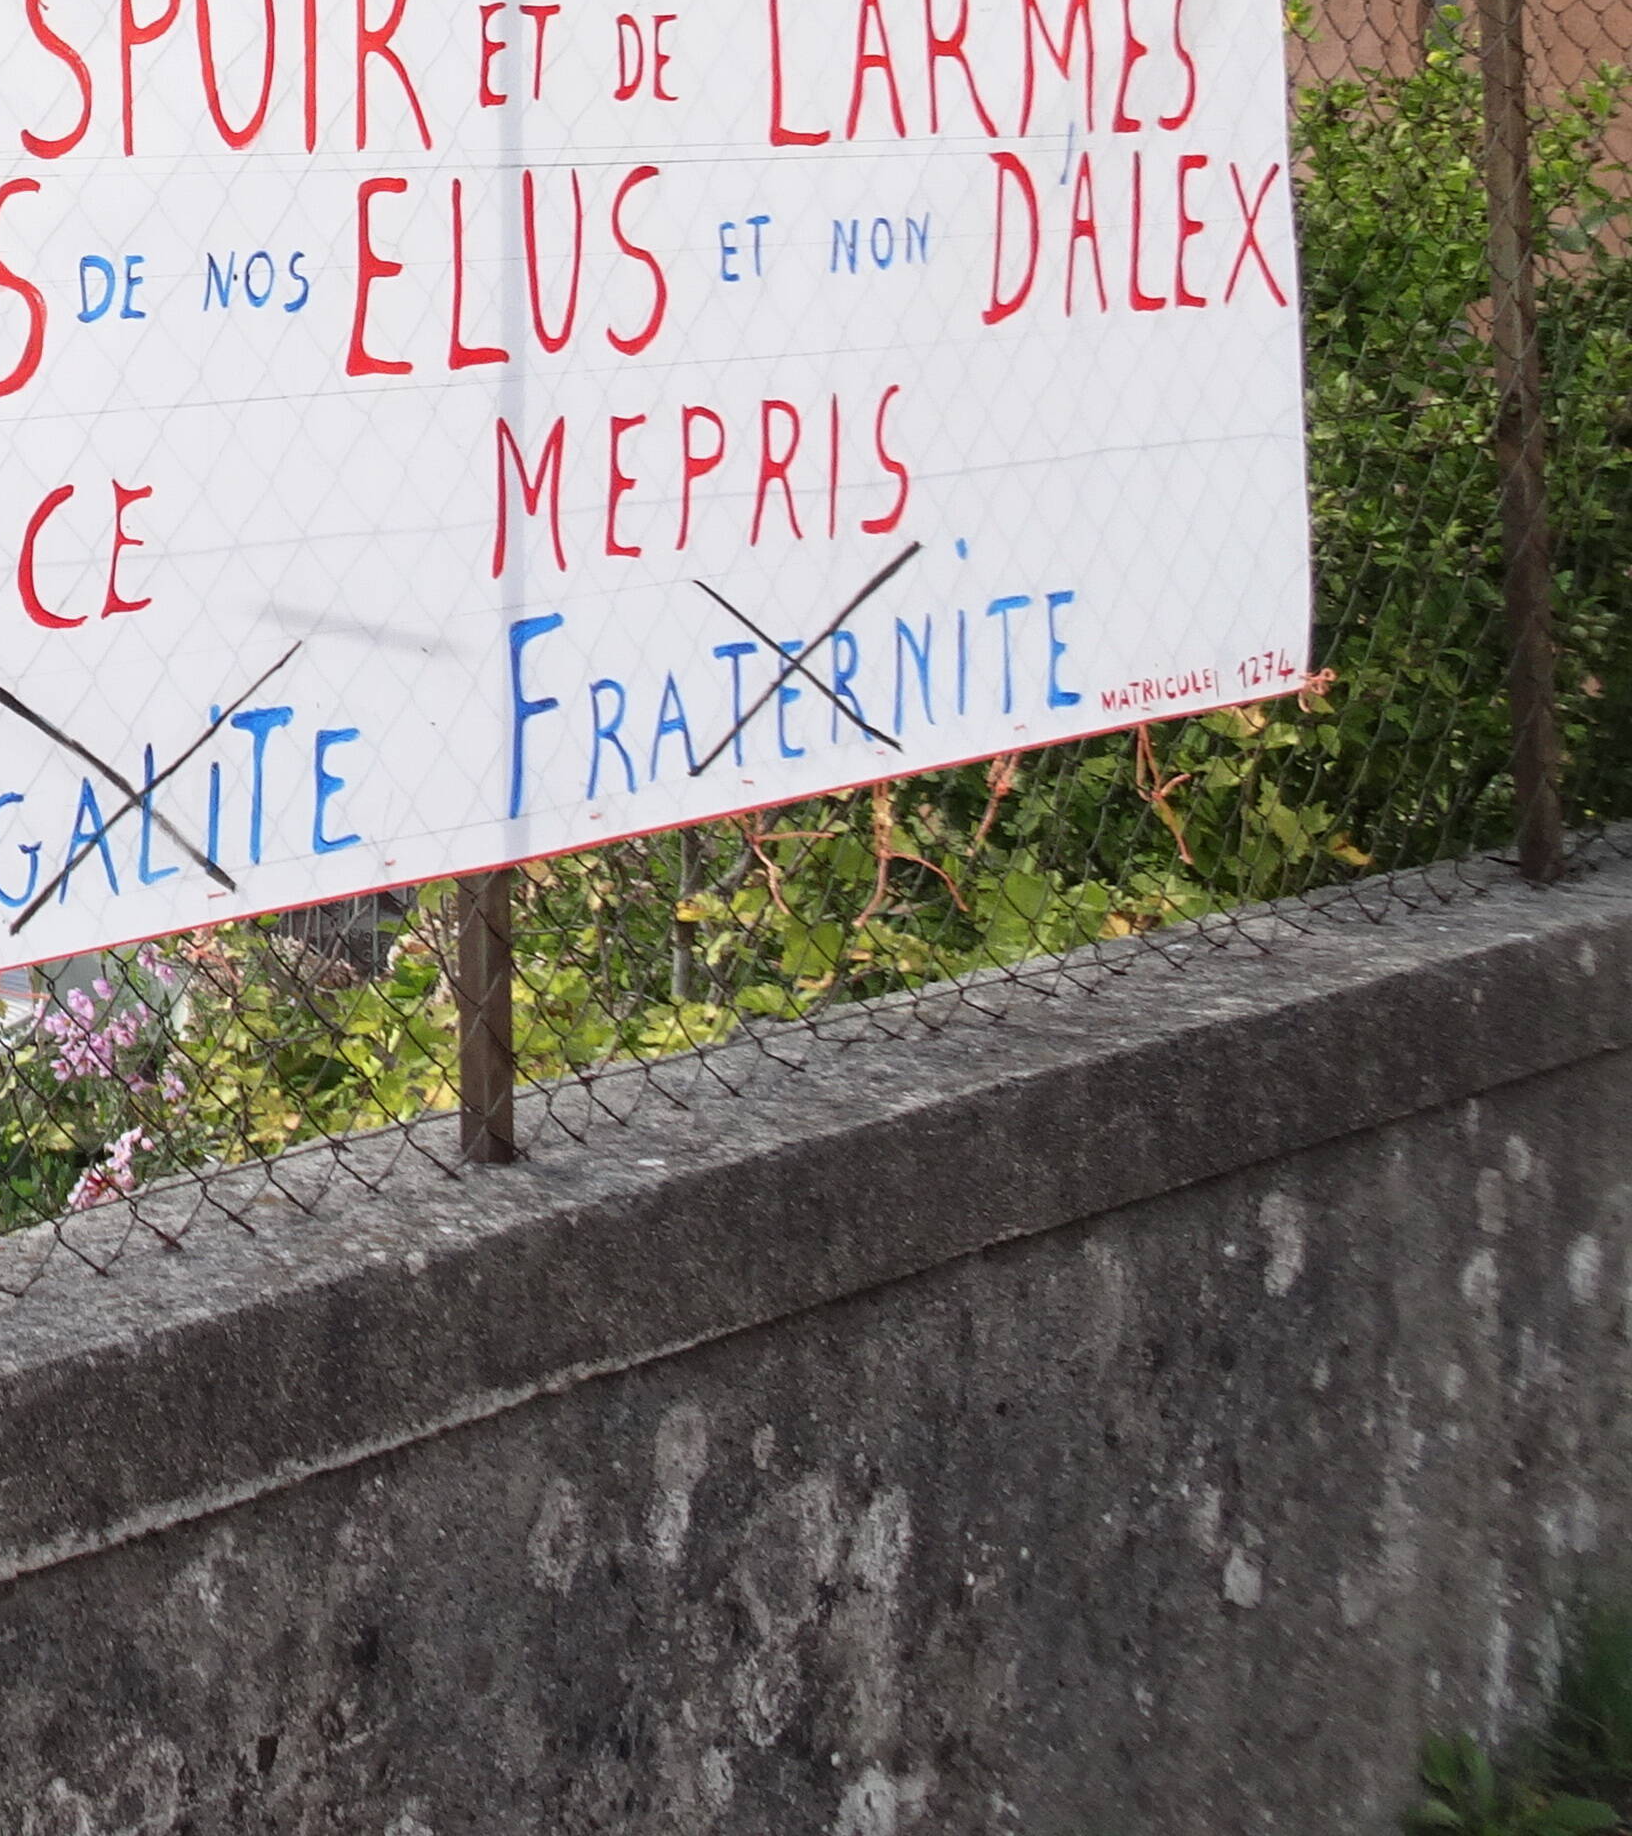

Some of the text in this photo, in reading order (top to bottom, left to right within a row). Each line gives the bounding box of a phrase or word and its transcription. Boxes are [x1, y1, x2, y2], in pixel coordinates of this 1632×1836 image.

[479, 0, 562, 109] ET
[614, 12, 681, 105] DE
[74, 252, 149, 324] DE
[203, 248, 313, 314] NOS
[345, 165, 669, 376] ELUS
[718, 213, 771, 284] ET
[830, 210, 933, 276] NON
[490, 383, 912, 580] MEPRIS
[508, 540, 1083, 820] FRATERNITE
[1236, 647, 1297, 690] 1274
